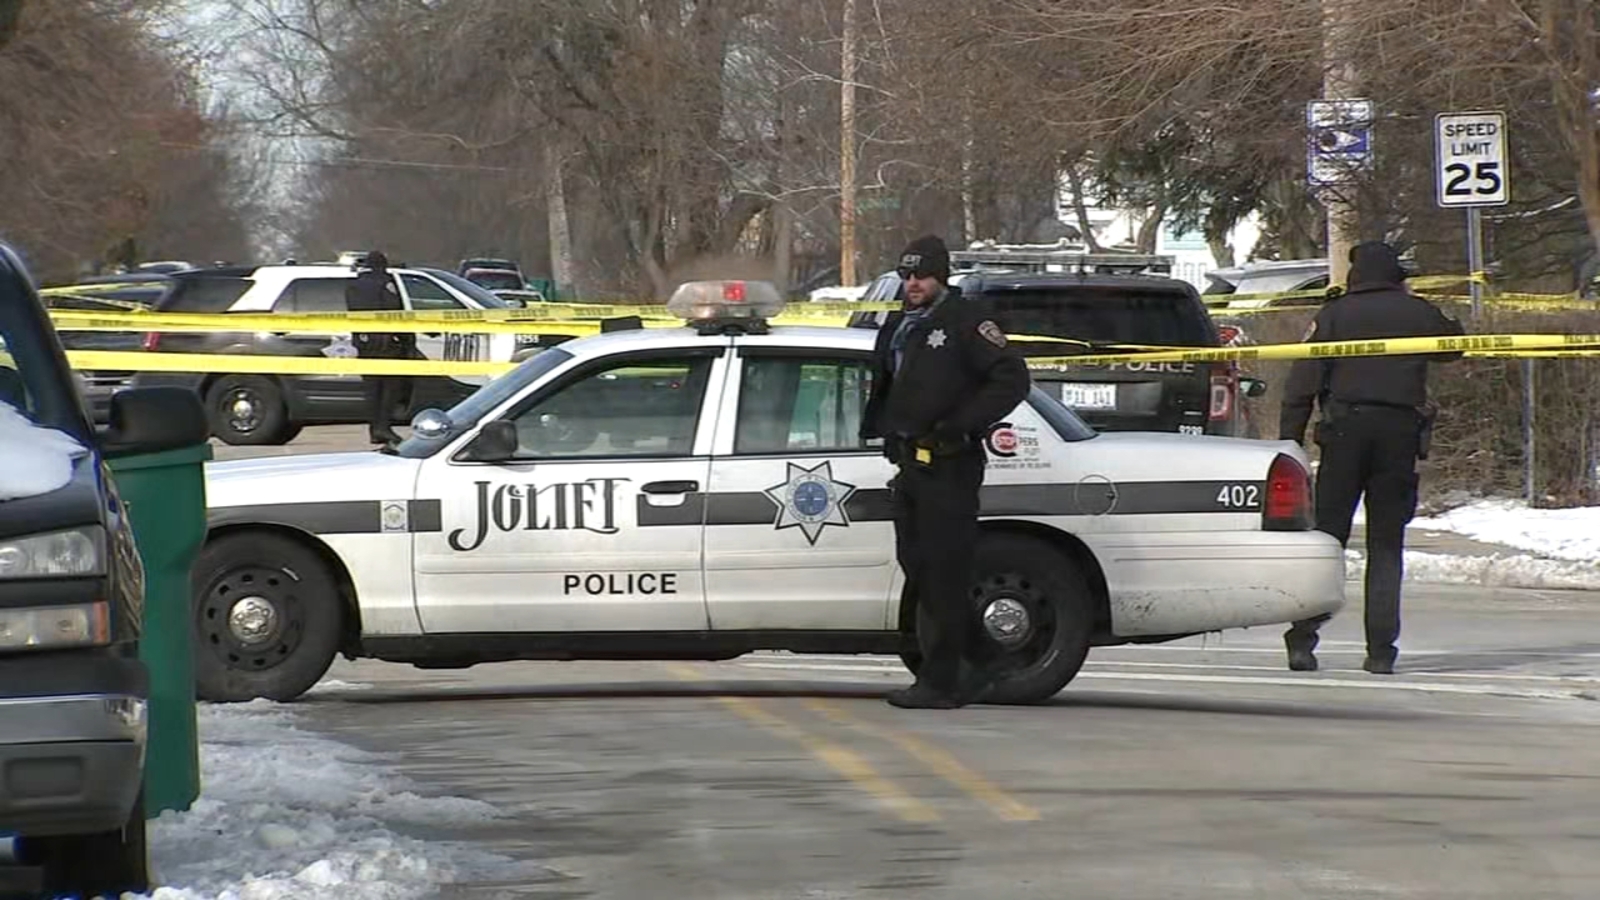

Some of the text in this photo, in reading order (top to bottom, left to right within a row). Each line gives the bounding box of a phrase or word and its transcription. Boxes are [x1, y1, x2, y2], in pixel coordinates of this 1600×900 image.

[1444, 123, 1497, 137] SPEED
[1451, 142, 1492, 156] LIMIT
[1444, 162, 1501, 196] 25
[1108, 358, 1195, 374] POLICE
[1216, 485, 1260, 507] 402
[448, 477, 632, 551] JOLIET
[564, 573, 677, 595] POLICE
